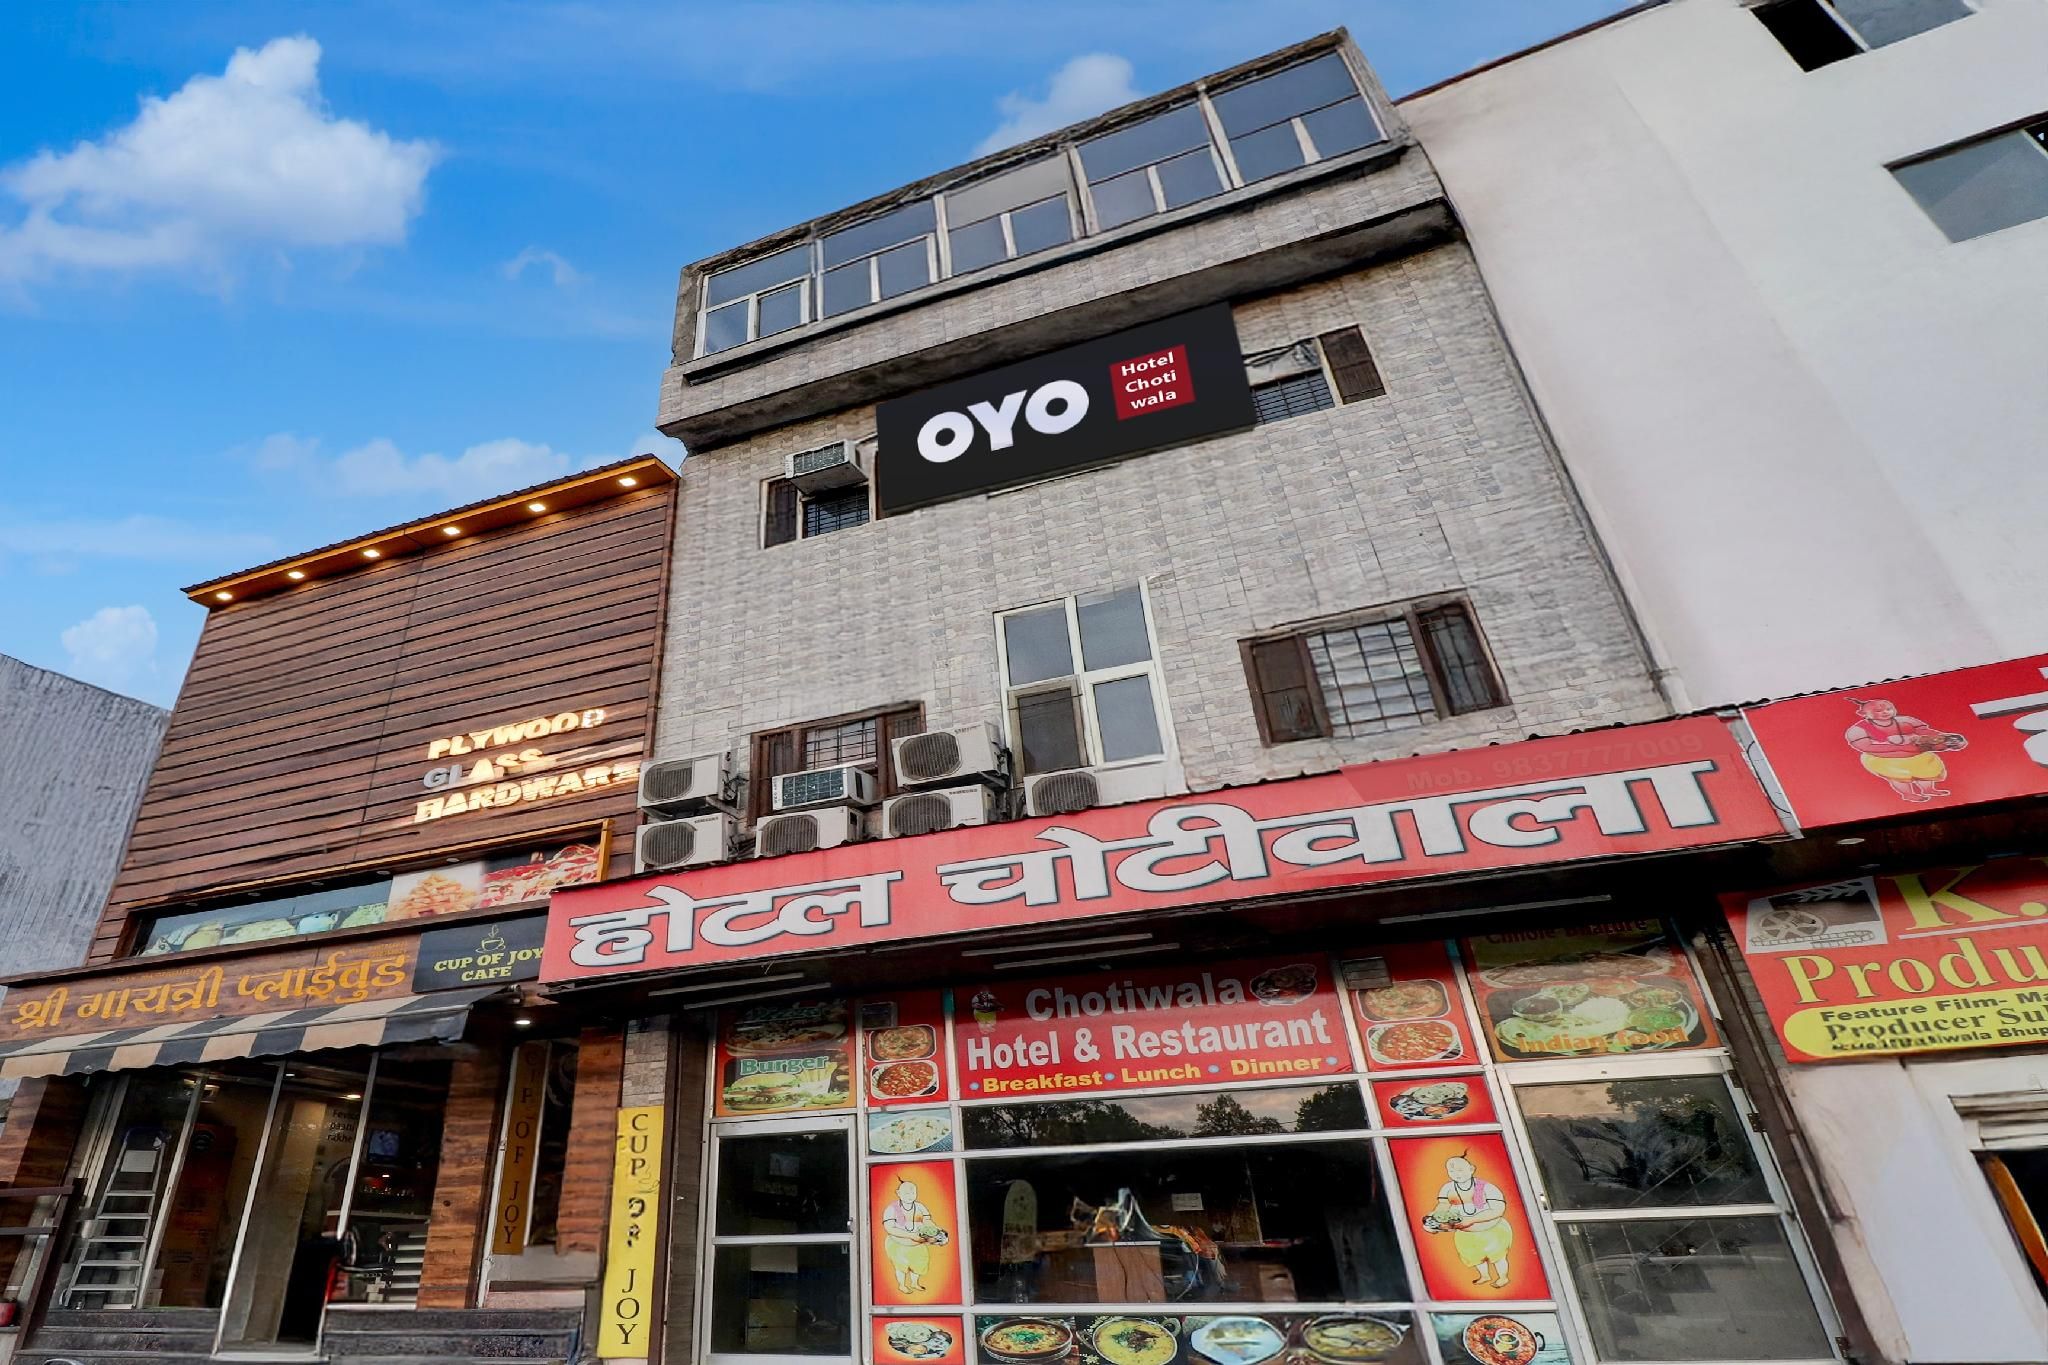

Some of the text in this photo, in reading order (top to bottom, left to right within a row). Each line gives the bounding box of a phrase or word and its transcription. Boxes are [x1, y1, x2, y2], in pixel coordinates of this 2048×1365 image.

[1121, 351, 1174, 377] Hotel
[1125, 369, 1177, 393] Choti
[1130, 389, 1177, 410] wala
[917, 379, 1090, 463] OYO
[423, 748, 545, 789] GLASS
[1407, 765, 1482, 792] Mob.
[569, 760, 1720, 968] होटल चोटीवाला
[433, 956, 473, 972] CUP
[476, 952, 505, 966] OF
[461, 966, 512, 981] CAFE
[11, 950, 409, 1030] श्री गायत्री प्लाईवुड
[1025, 973, 1246, 1021] Chotiwala
[1820, 1003, 1928, 1022] Feature
[1825, 1012, 1986, 1040] Producer
[967, 1009, 1332, 1070] Hotel & Restaurant
[1516, 1026, 1690, 1055] Indian food
[740, 1055, 829, 1076] Burger
[982, 1056, 1322, 1093] Breakfast Lunch Dinner
[514, 1119, 531, 1165] OF
[629, 1113, 650, 1177] CUP
[503, 1180, 520, 1245] JOY
[615, 1267, 641, 1346] JOY
